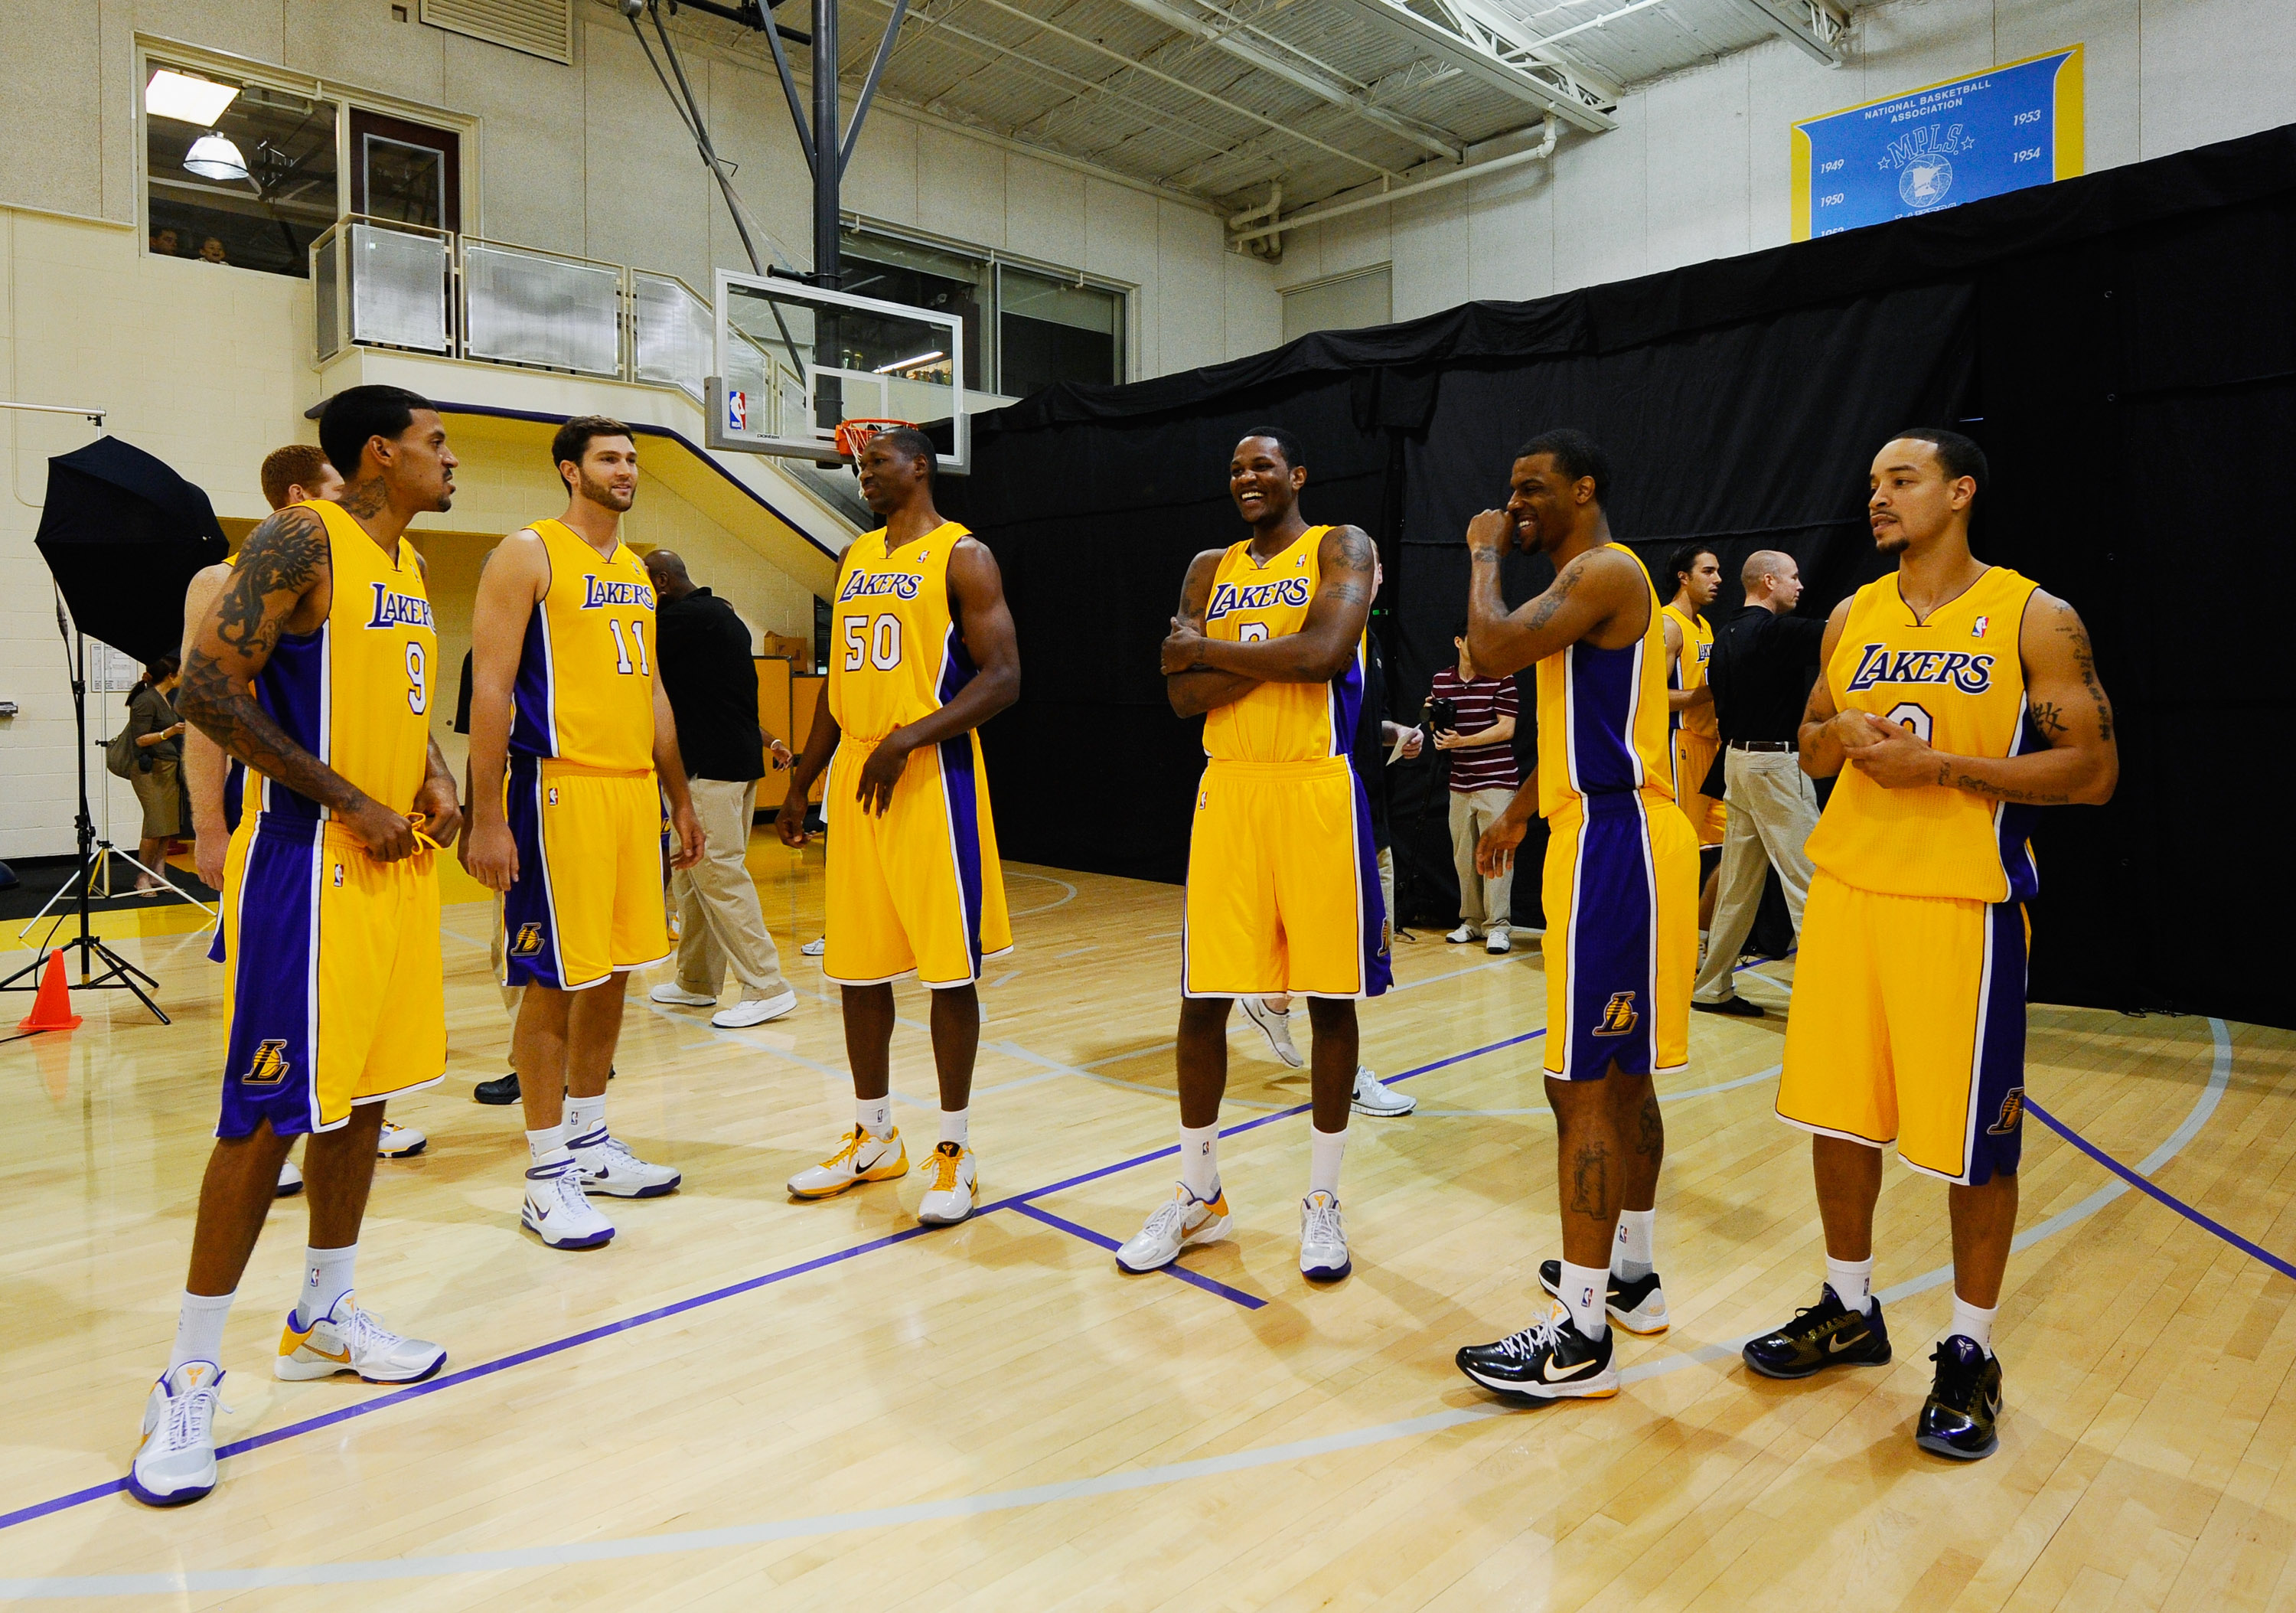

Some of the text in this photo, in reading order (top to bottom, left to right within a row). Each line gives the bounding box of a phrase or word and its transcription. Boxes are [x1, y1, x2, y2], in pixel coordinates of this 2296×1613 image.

[1864, 80, 1991, 120] NATIONAL BASKETBALL
[1890, 97, 1963, 123] ASSOCIATION
[2014, 109, 2041, 126] 1953
[1821, 158, 1844, 174] 1949
[2014, 146, 2041, 163] 1954
[1821, 192, 1844, 207] 1950
[580, 573, 655, 611] LAKERS
[837, 569, 925, 604] LAKERS
[1205, 576, 1310, 623] LAKERS
[609, 619, 651, 677] 11
[843, 612, 902, 673] 50
[404, 641, 427, 716] 9
[1845, 643, 1996, 695] LAKERS
